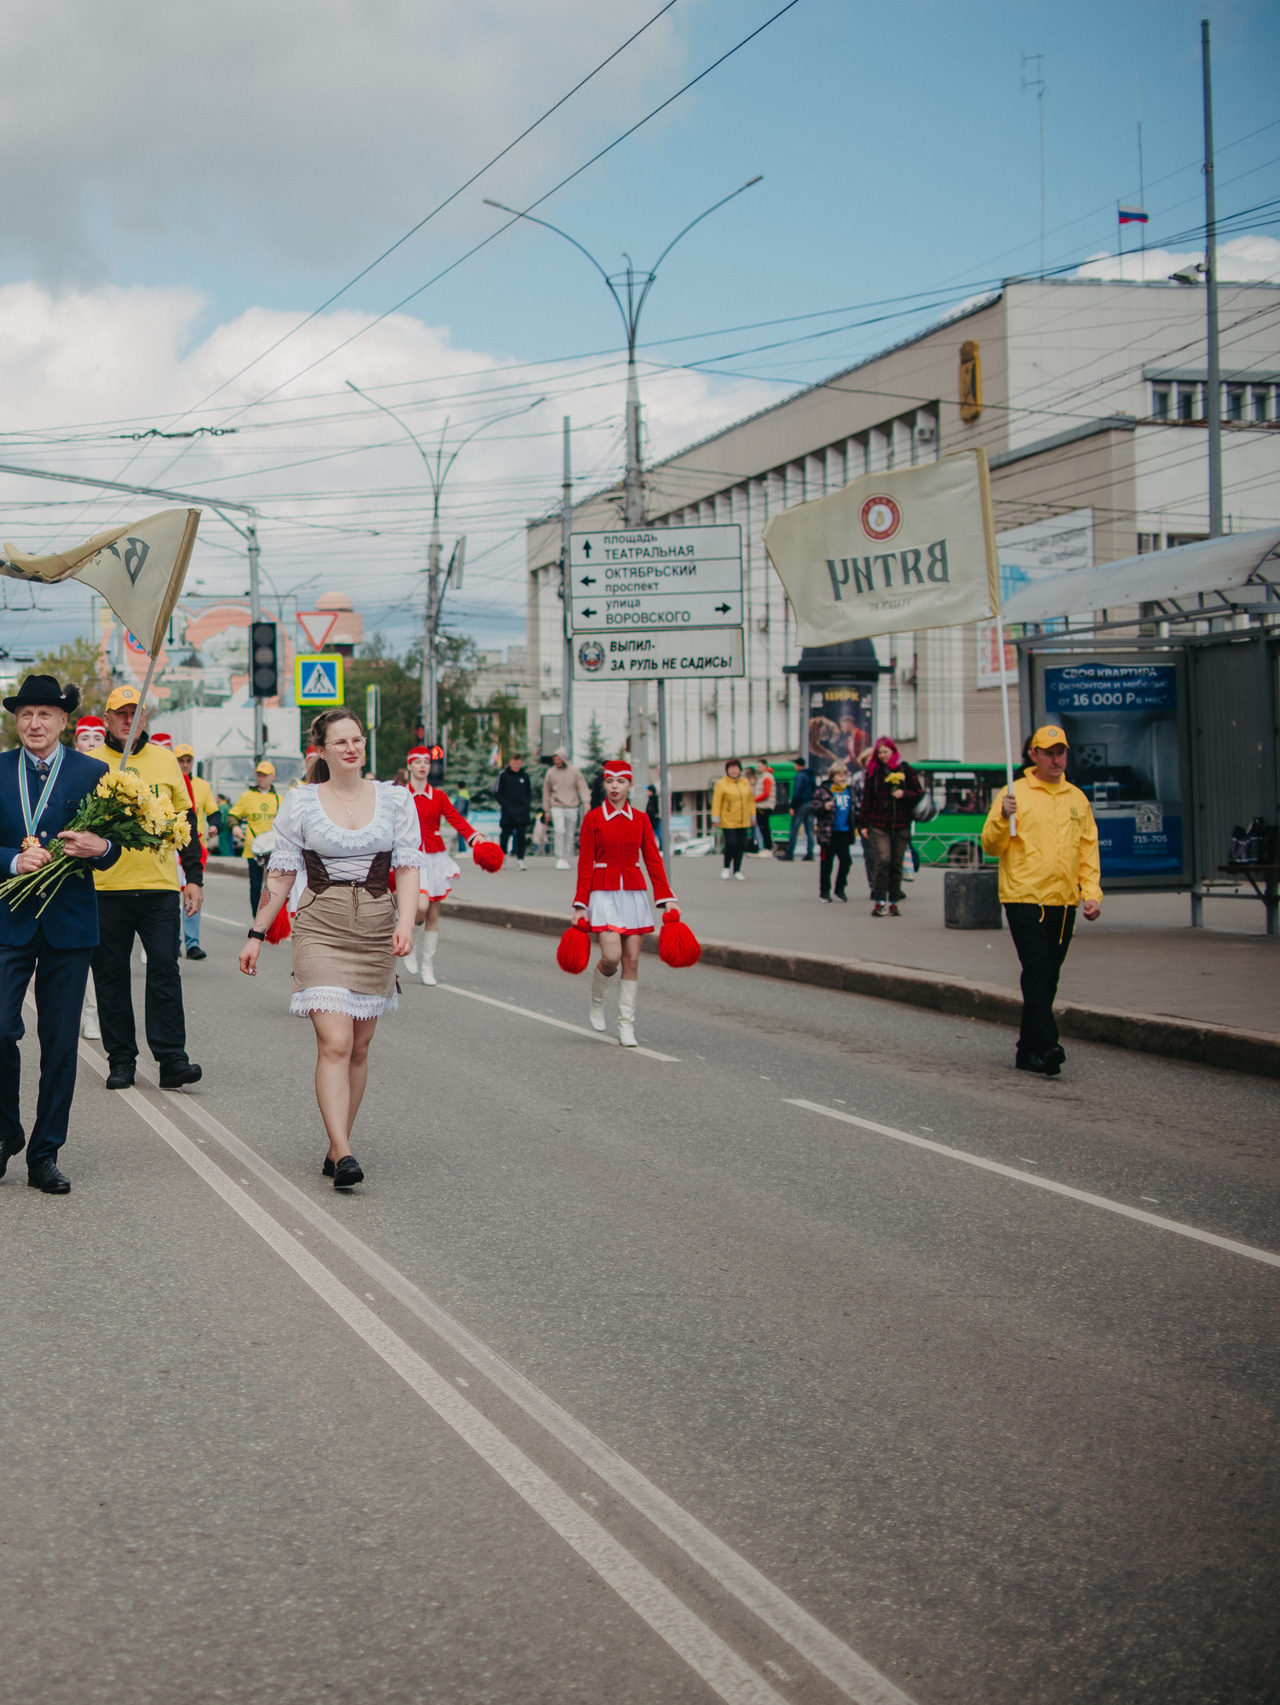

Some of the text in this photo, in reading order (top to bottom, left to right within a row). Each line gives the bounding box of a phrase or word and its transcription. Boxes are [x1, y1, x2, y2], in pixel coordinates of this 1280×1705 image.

[604, 534, 658, 545] площадь
[605, 545, 695, 560] ТЕАТРАЛЬНАЯ
[605, 562, 697, 579] ОКТЯБРЬСКИЙ
[605, 582, 660, 595] проспект
[606, 599, 641, 611] улица
[606, 611, 691, 624] ВОРОВСКОГО
[610, 640, 655, 652] ВЫПИЛ-
[611, 656, 732, 671] ЗА РУЛЬ НЕ САДИСЬ!
[1062, 666, 1158, 679] СВОЯ КВАРТИРА
[1059, 681, 1111, 691] ремонтом
[1123, 679, 1169, 688] мебелью
[1058, 698, 1070, 706] от
[1072, 694, 1089, 706] 16
[1092, 693, 1122, 706] 000
